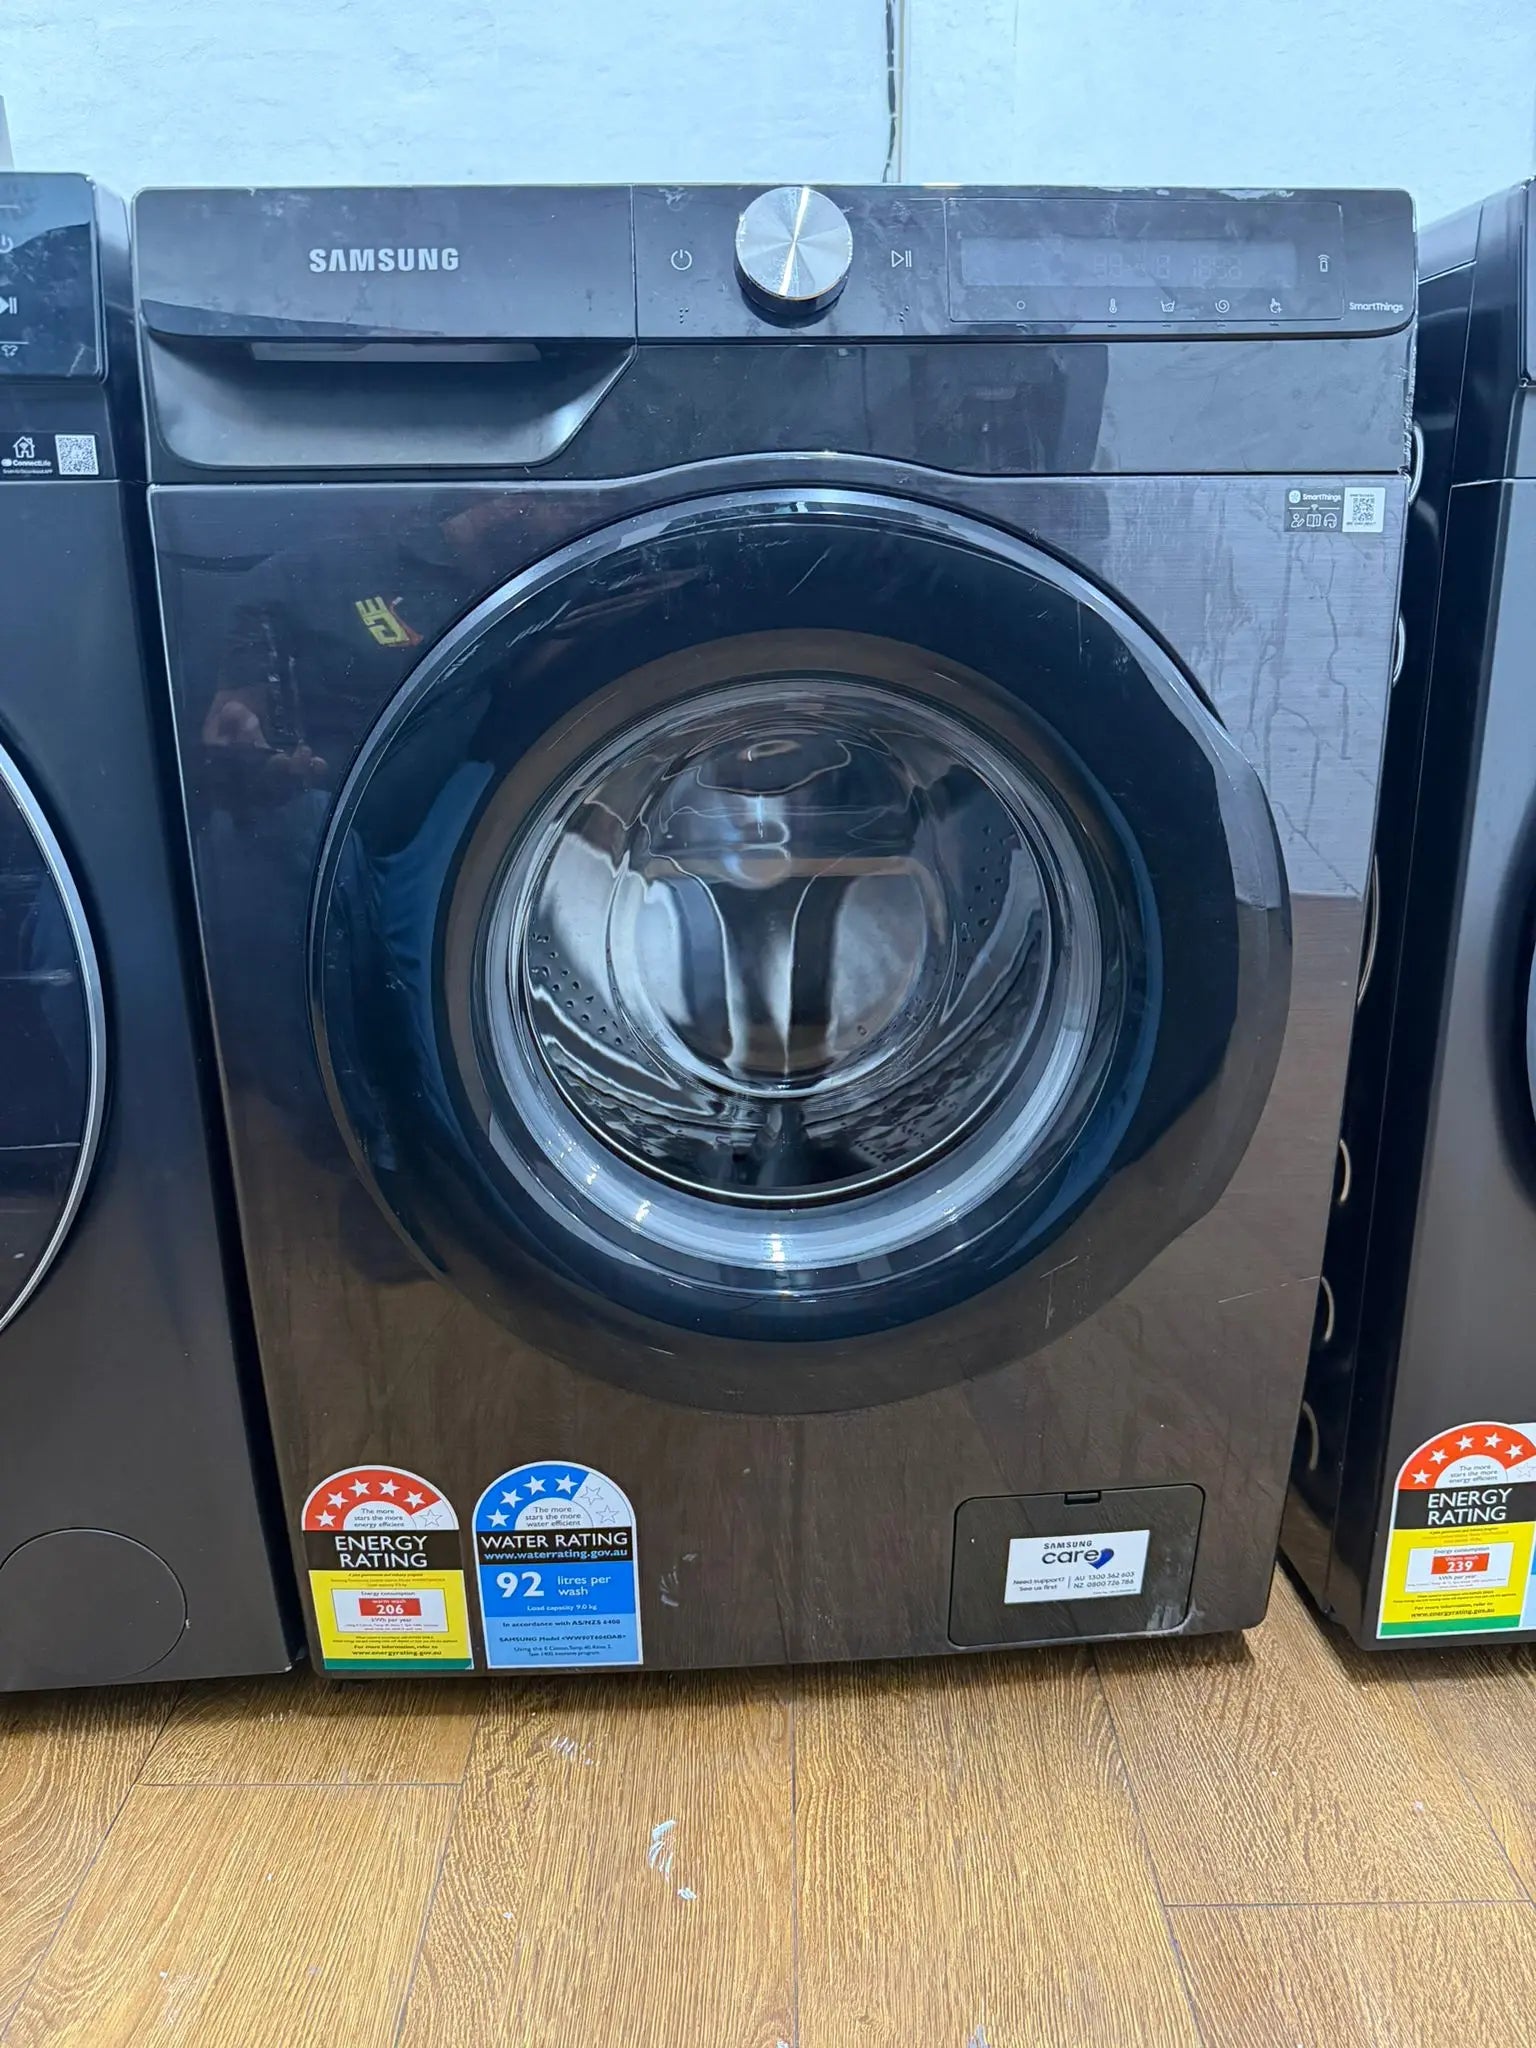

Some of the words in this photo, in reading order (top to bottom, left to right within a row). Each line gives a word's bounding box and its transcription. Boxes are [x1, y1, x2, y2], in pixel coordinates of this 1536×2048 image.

[309, 248, 459, 273] SAMSUNG
[1349, 302, 1404, 313] SmartThings
[1302, 493, 1342, 503] SmartThings
[1427, 1488, 1513, 1509] ENERGY
[1427, 1506, 1507, 1525] RATING
[335, 1535, 428, 1550] ENERGY
[480, 1535, 549, 1549] WATER
[555, 1532, 628, 1547] RATING
[1043, 1540, 1093, 1550] SAMSUNG
[340, 1553, 428, 1568] RATING
[484, 1549, 628, 1560] www.waterrating.gov.au
[1042, 1549, 1099, 1565] care
[1446, 1560, 1473, 1572] 239
[496, 1571, 545, 1598] 92
[557, 1575, 587, 1585] litres
[591, 1575, 611, 1586] per
[558, 1587, 588, 1596] wash
[377, 1604, 404, 1615] 206
